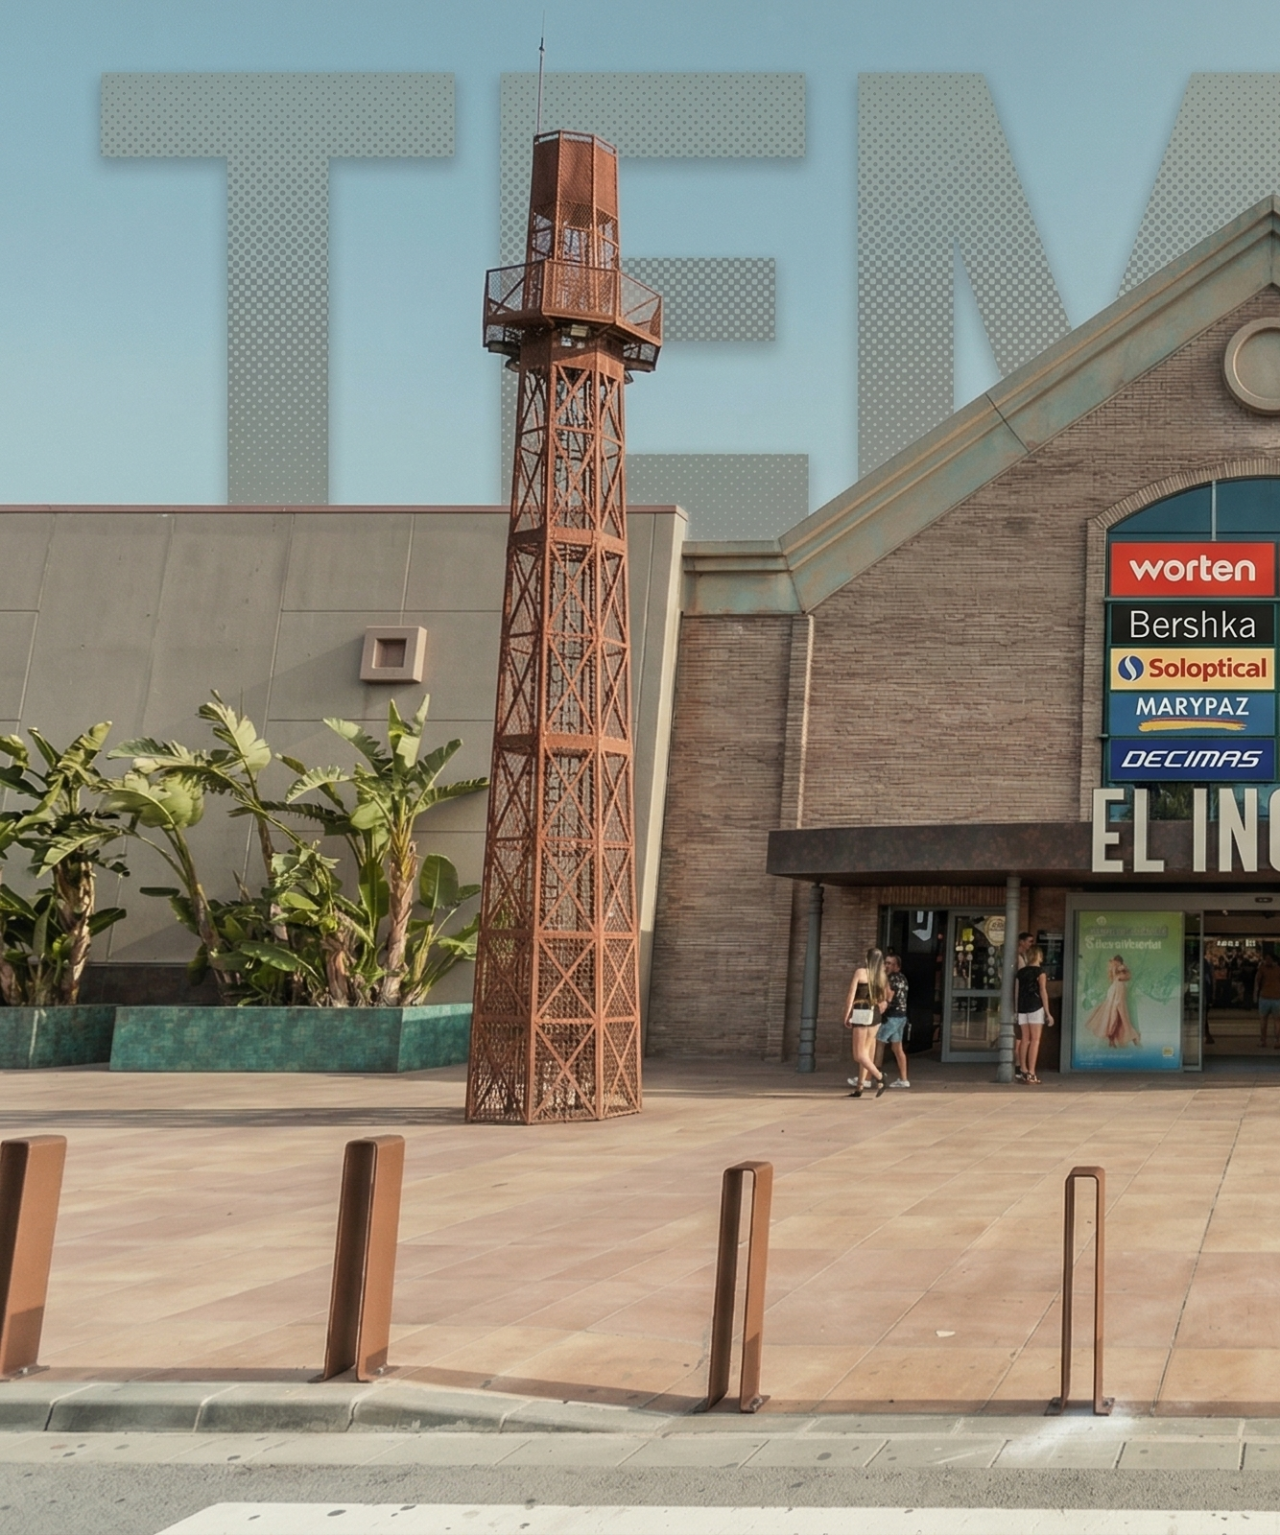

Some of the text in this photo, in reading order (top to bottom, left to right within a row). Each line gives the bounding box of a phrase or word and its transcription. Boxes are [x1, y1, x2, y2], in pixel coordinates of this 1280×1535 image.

[1129, 555, 1256, 581] worten
[1130, 610, 1256, 638] Bershka
[1149, 657, 1267, 682] Soloptical
[1136, 697, 1249, 716] MARYPAZ
[1121, 750, 1263, 768] DECIMAS
[1091, 788, 1165, 873] EL
